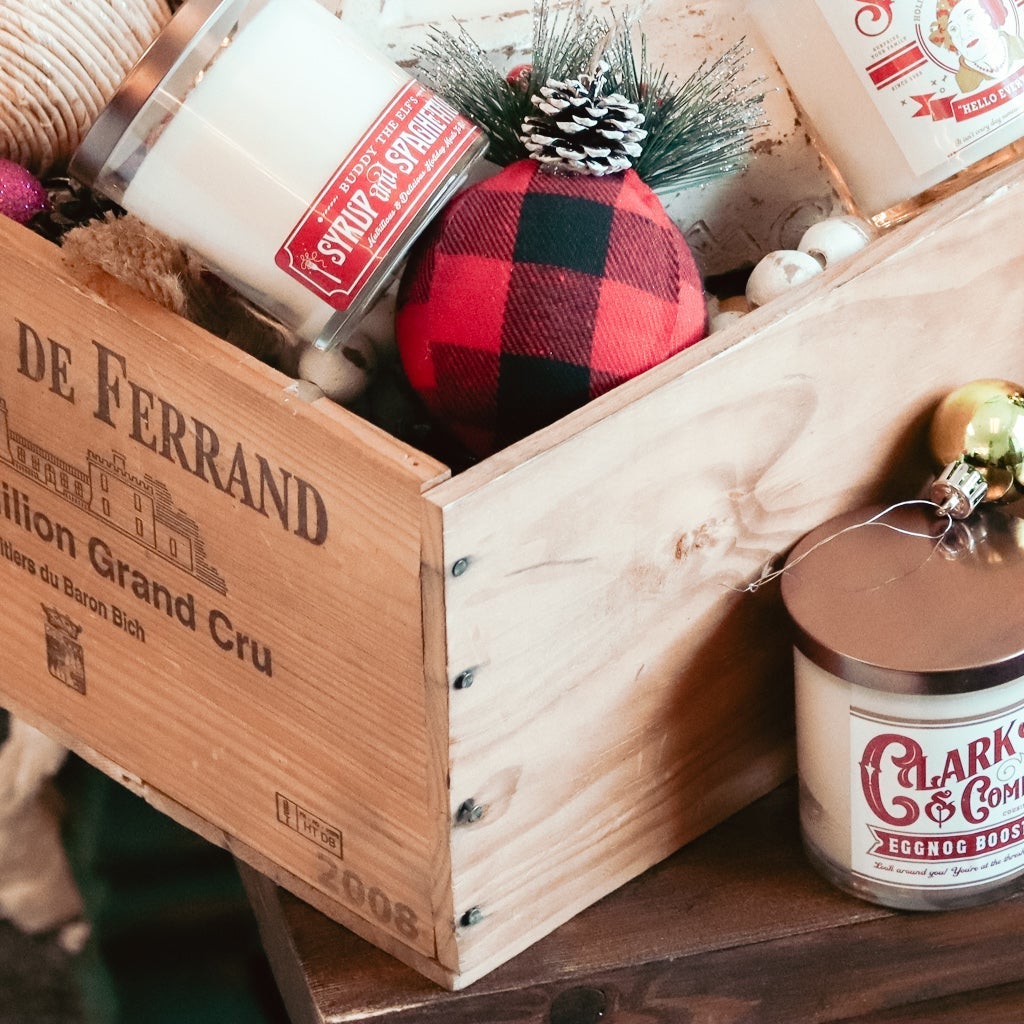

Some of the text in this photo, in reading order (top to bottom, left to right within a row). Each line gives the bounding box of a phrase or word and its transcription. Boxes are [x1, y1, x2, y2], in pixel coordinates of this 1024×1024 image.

[339, 95, 419, 194] BUDDY THE ELF'S
[399, 170, 427, 204] Delicious
[317, 189, 379, 266] SYRUP
[14, 318, 329, 546] DE FERRAND
[40, 563, 59, 589] du
[63, 575, 108, 619] Baron
[111, 604, 146, 643] Bich
[88, 537, 196, 631] Grand
[209, 609, 273, 677] Cru
[859, 719, 1017, 827] CLARK
[924, 790, 956, 829] &
[889, 837, 967, 857] EGGNOG
[896, 867, 928, 876] around
[317, 852, 419, 940] 2008
